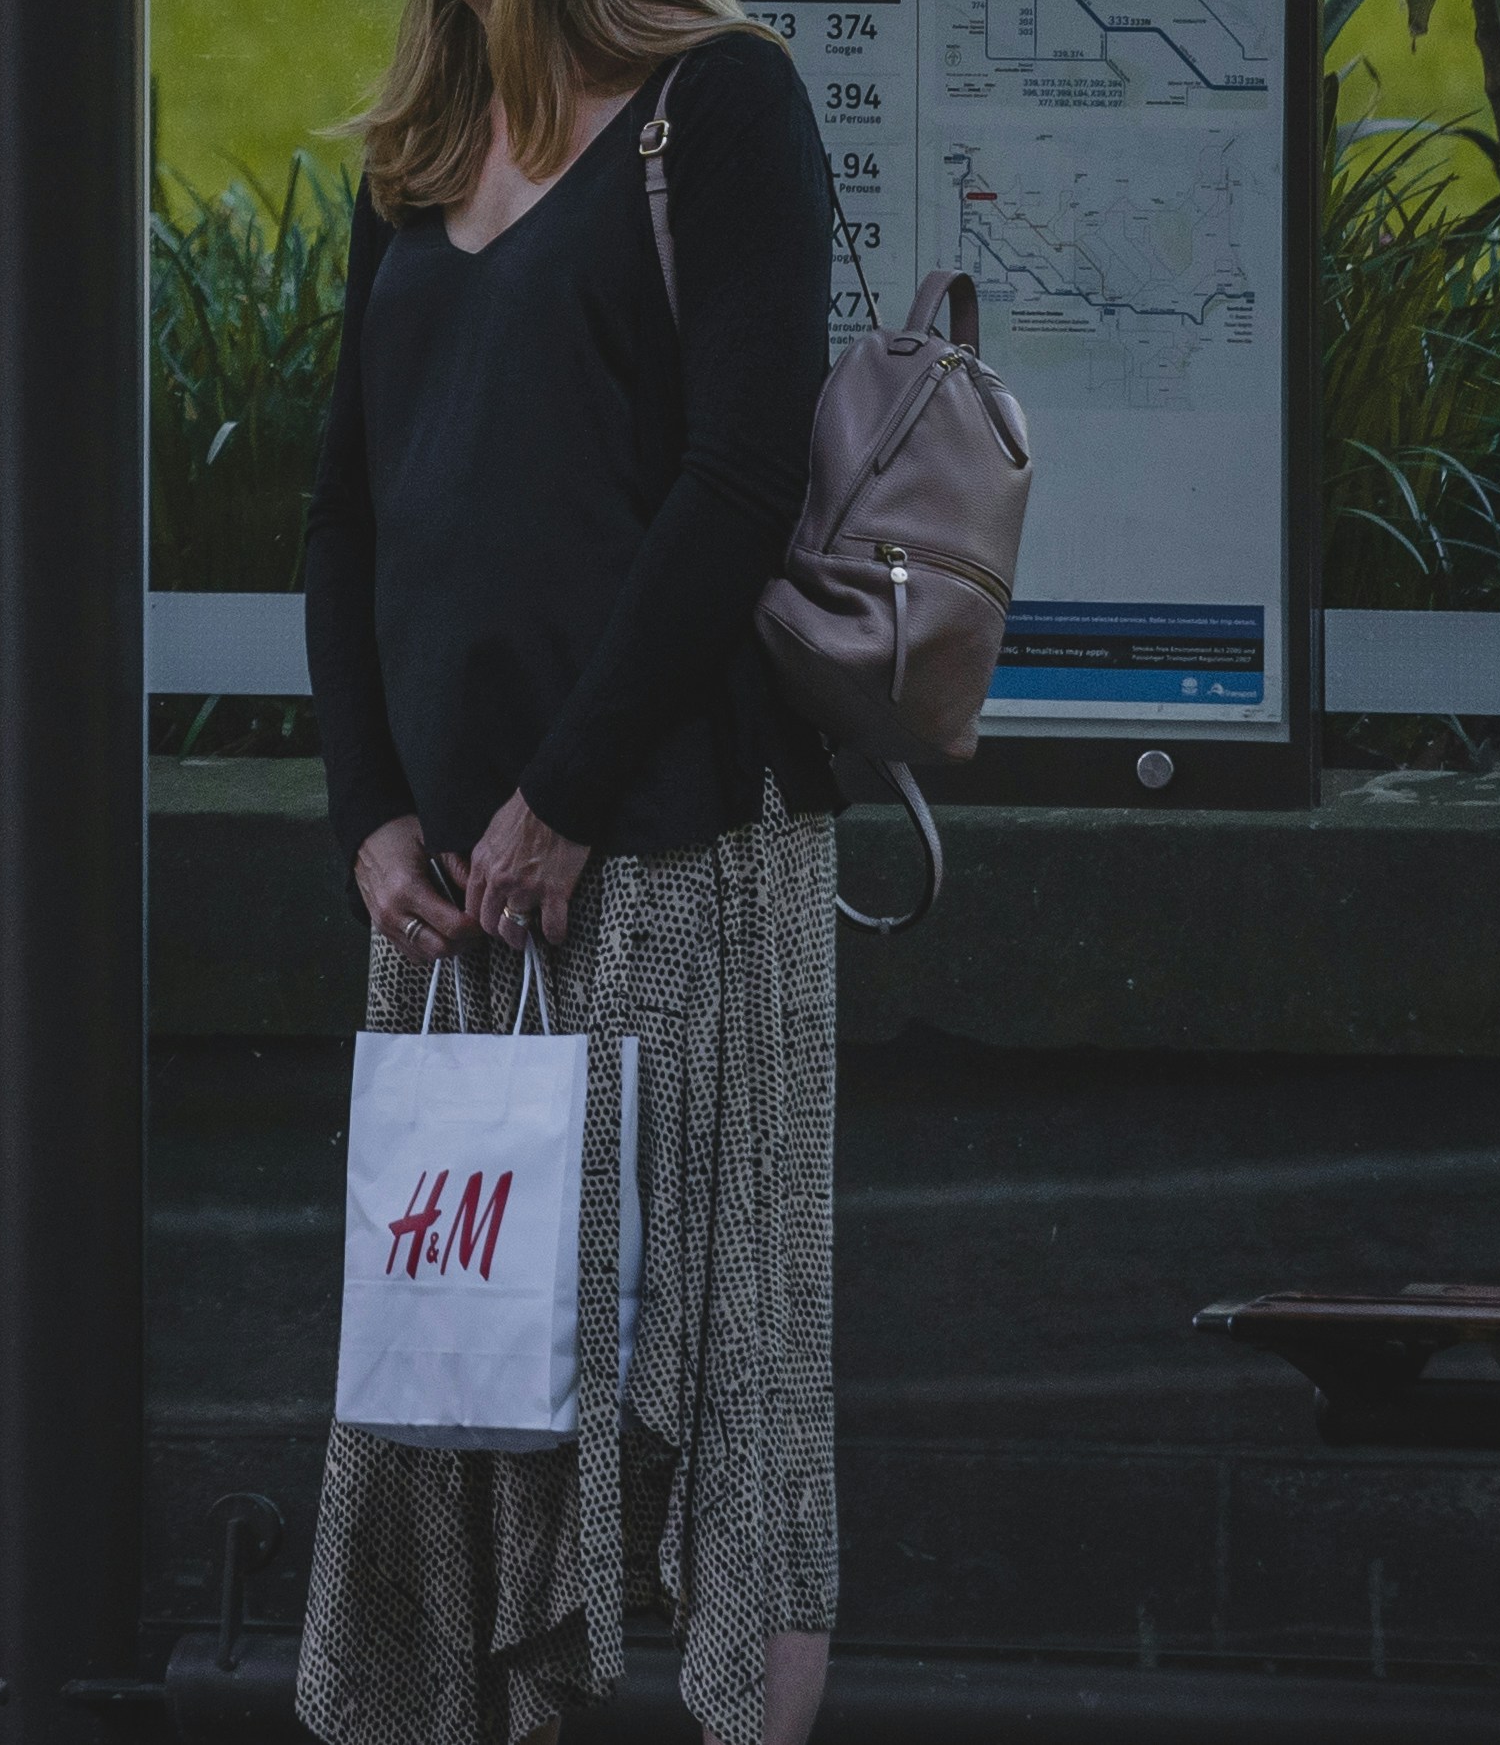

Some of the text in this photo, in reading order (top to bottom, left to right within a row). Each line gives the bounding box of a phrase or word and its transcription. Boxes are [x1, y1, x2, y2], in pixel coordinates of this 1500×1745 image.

[1108, 15, 1129, 25] 333
[826, 13, 878, 40] 374
[825, 43, 863, 56] Coogee
[1225, 74, 1245, 85] 333
[826, 83, 882, 110] 394
[824, 113, 882, 125] La Perouse
[839, 183, 881, 194] Perouse
[829, 335, 855, 345] each
[1025, 645, 1064, 656] Penalties
[1065, 647, 1084, 658] may
[1085, 647, 1109, 658] apply
[386, 1169, 513, 1282] H&M
